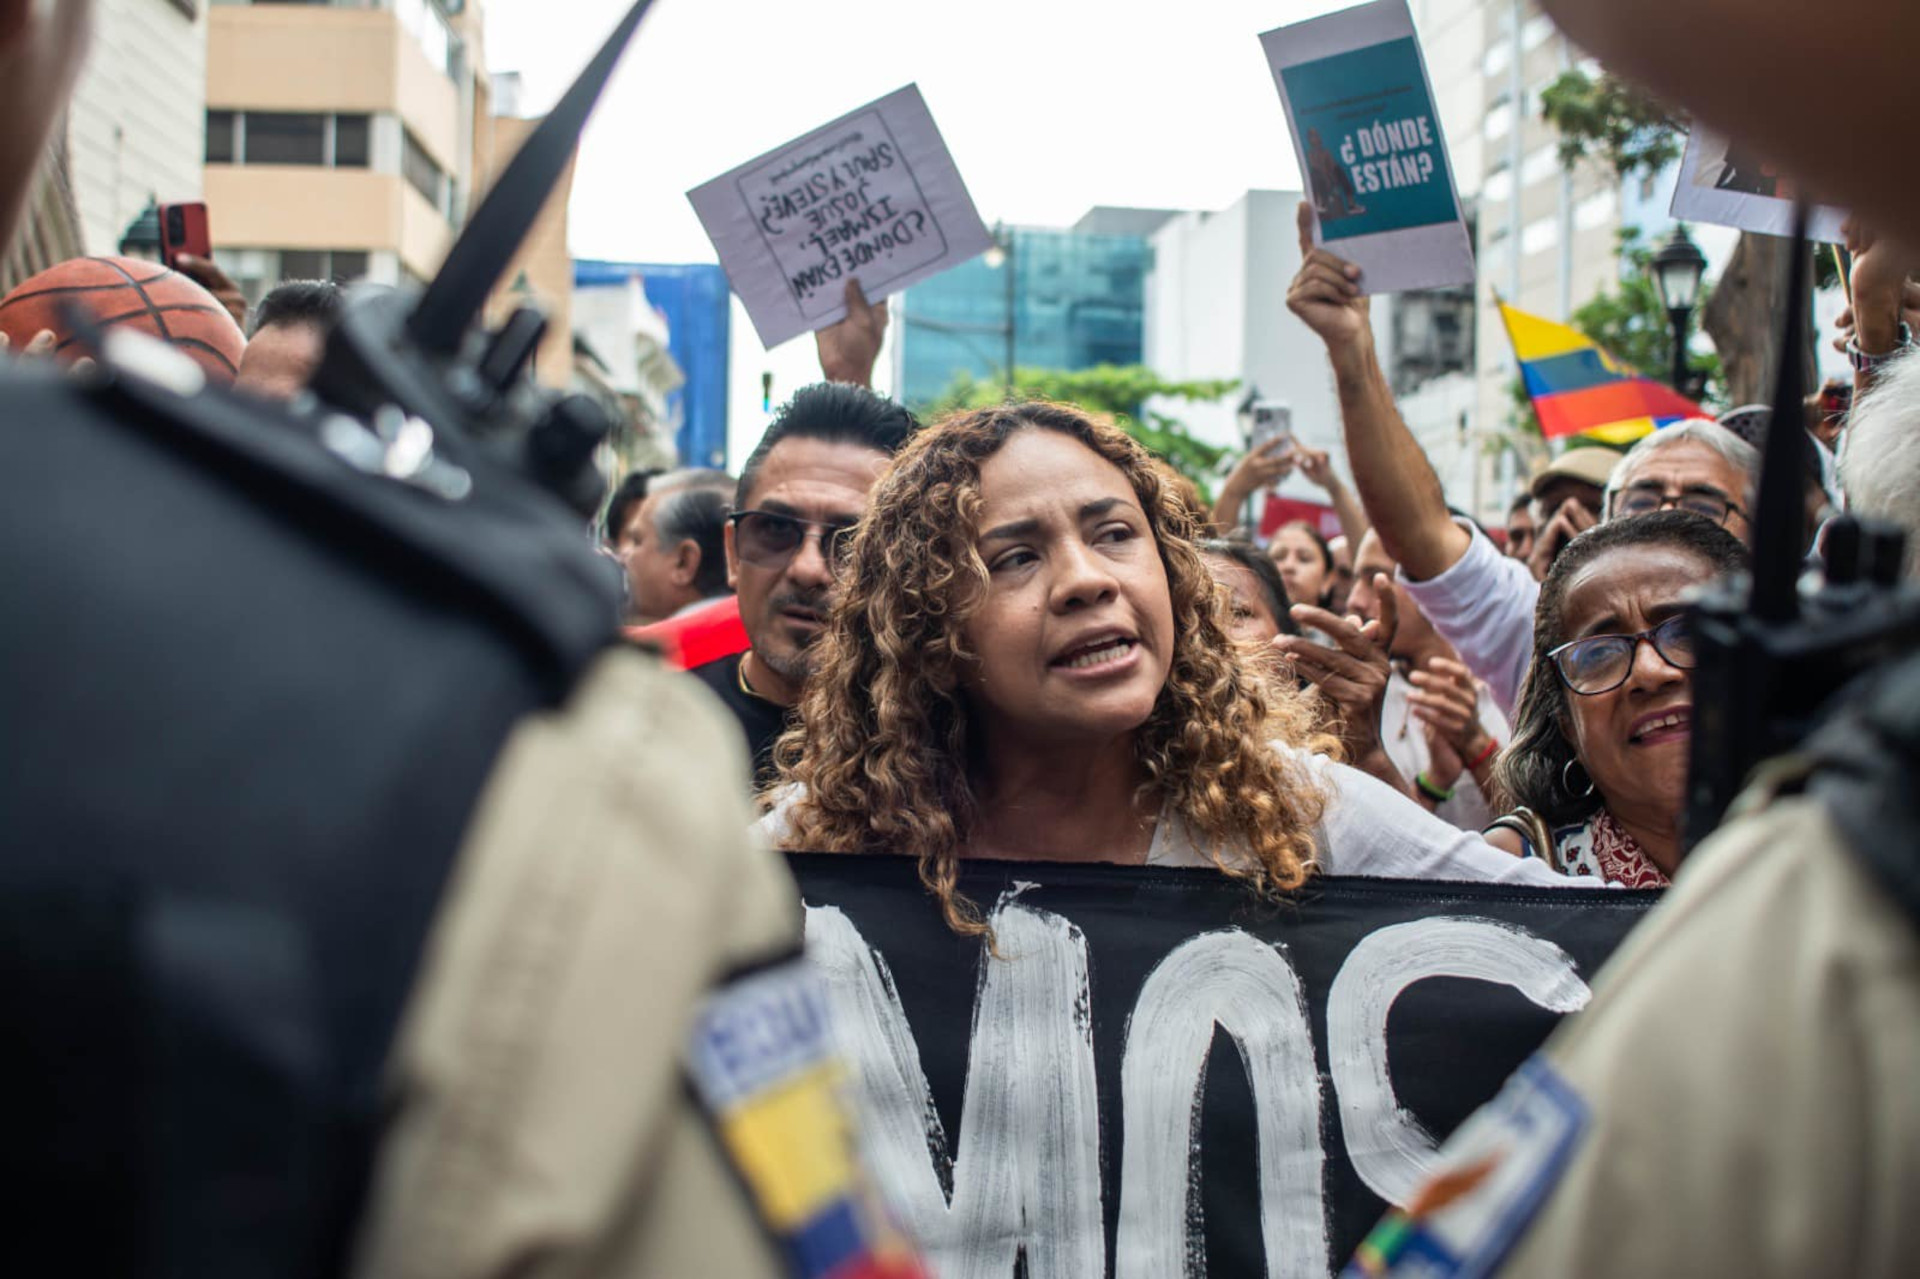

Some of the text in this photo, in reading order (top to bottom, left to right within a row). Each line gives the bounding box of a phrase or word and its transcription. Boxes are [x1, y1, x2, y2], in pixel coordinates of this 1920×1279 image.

[830, 166, 846, 190] Y
[1352, 152, 1434, 194] ESTÁN?
[760, 172, 828, 235] STEVE?
